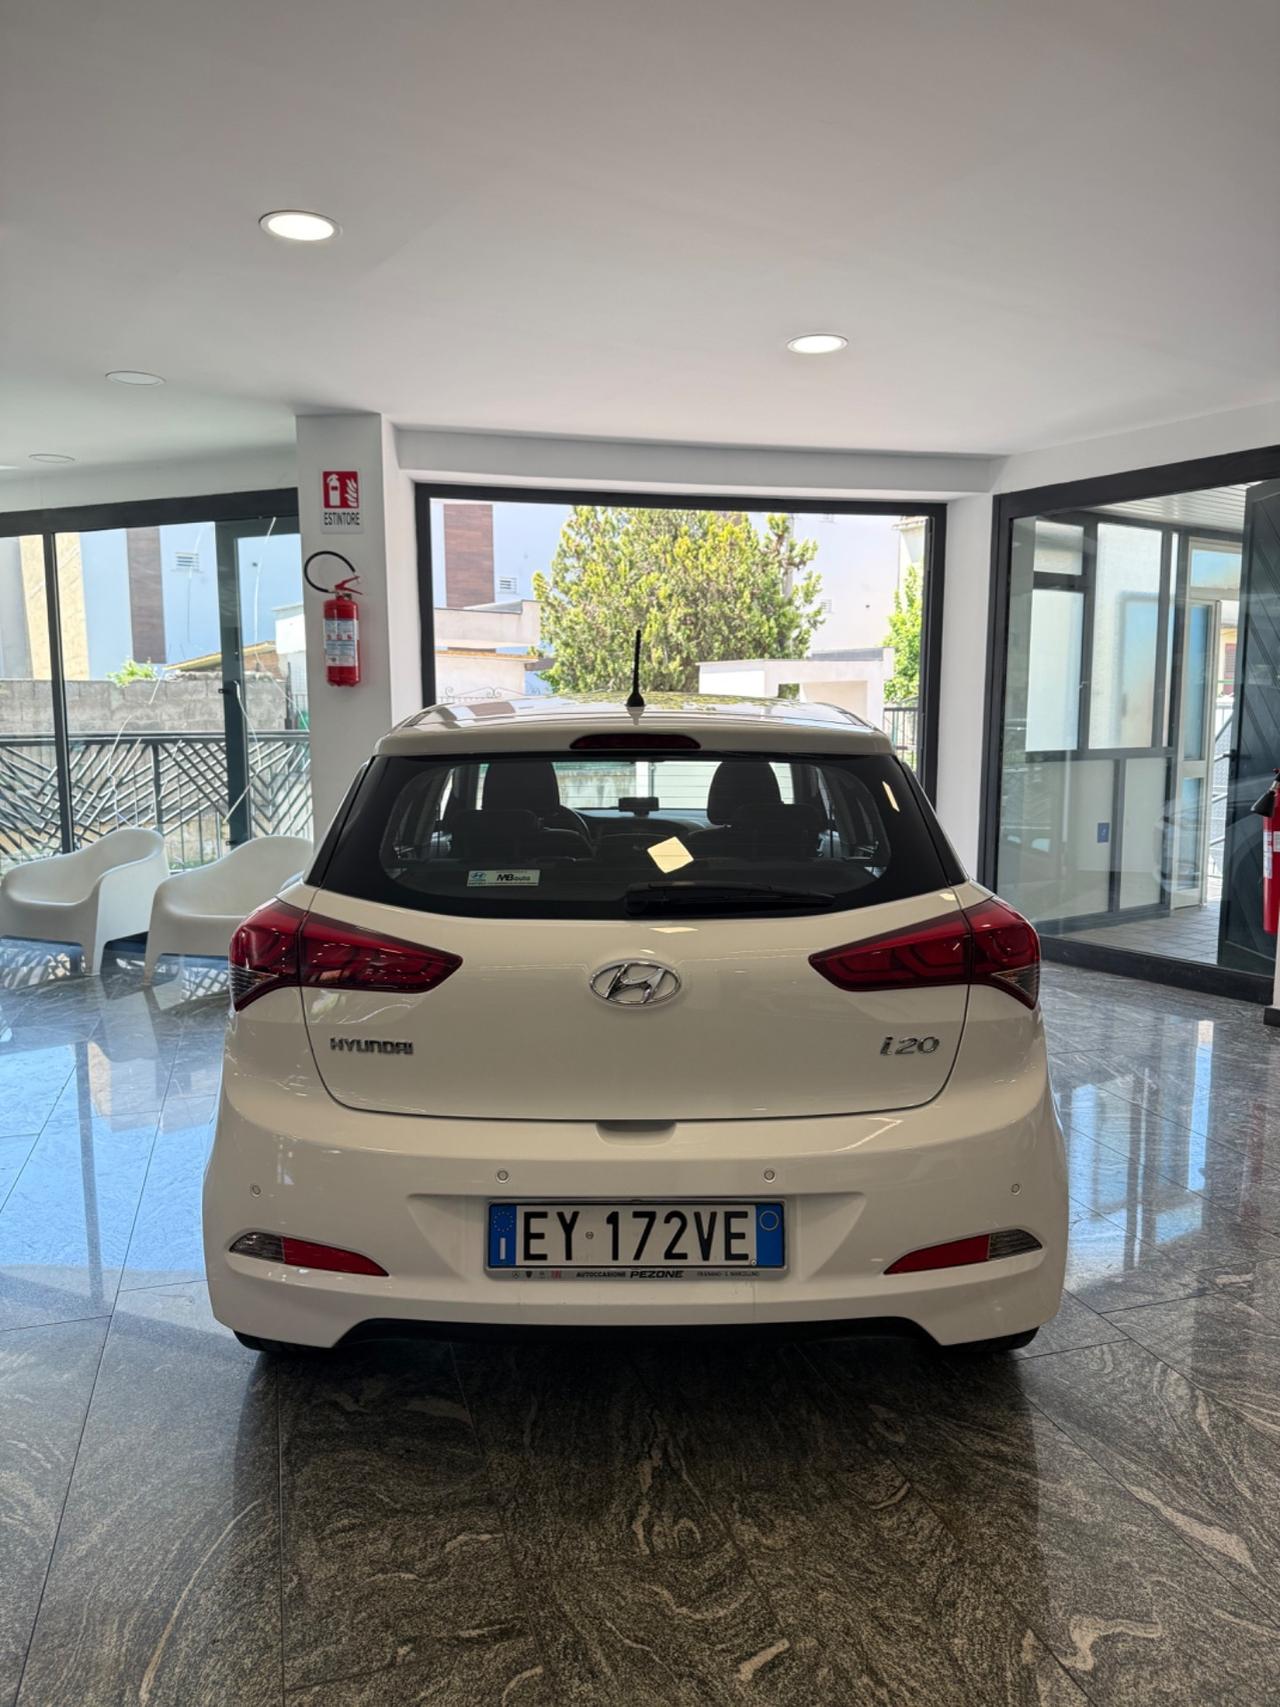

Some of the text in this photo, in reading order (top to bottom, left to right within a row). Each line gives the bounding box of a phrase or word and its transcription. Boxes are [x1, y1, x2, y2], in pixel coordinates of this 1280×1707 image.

[324, 512, 360, 525] ESTINTORE
[330, 1038, 413, 1055] HYUNDAI
[880, 1036, 939, 1054] i20
[523, 1211, 749, 1261] EY 172VE
[630, 1270, 684, 1279] PEZONE
